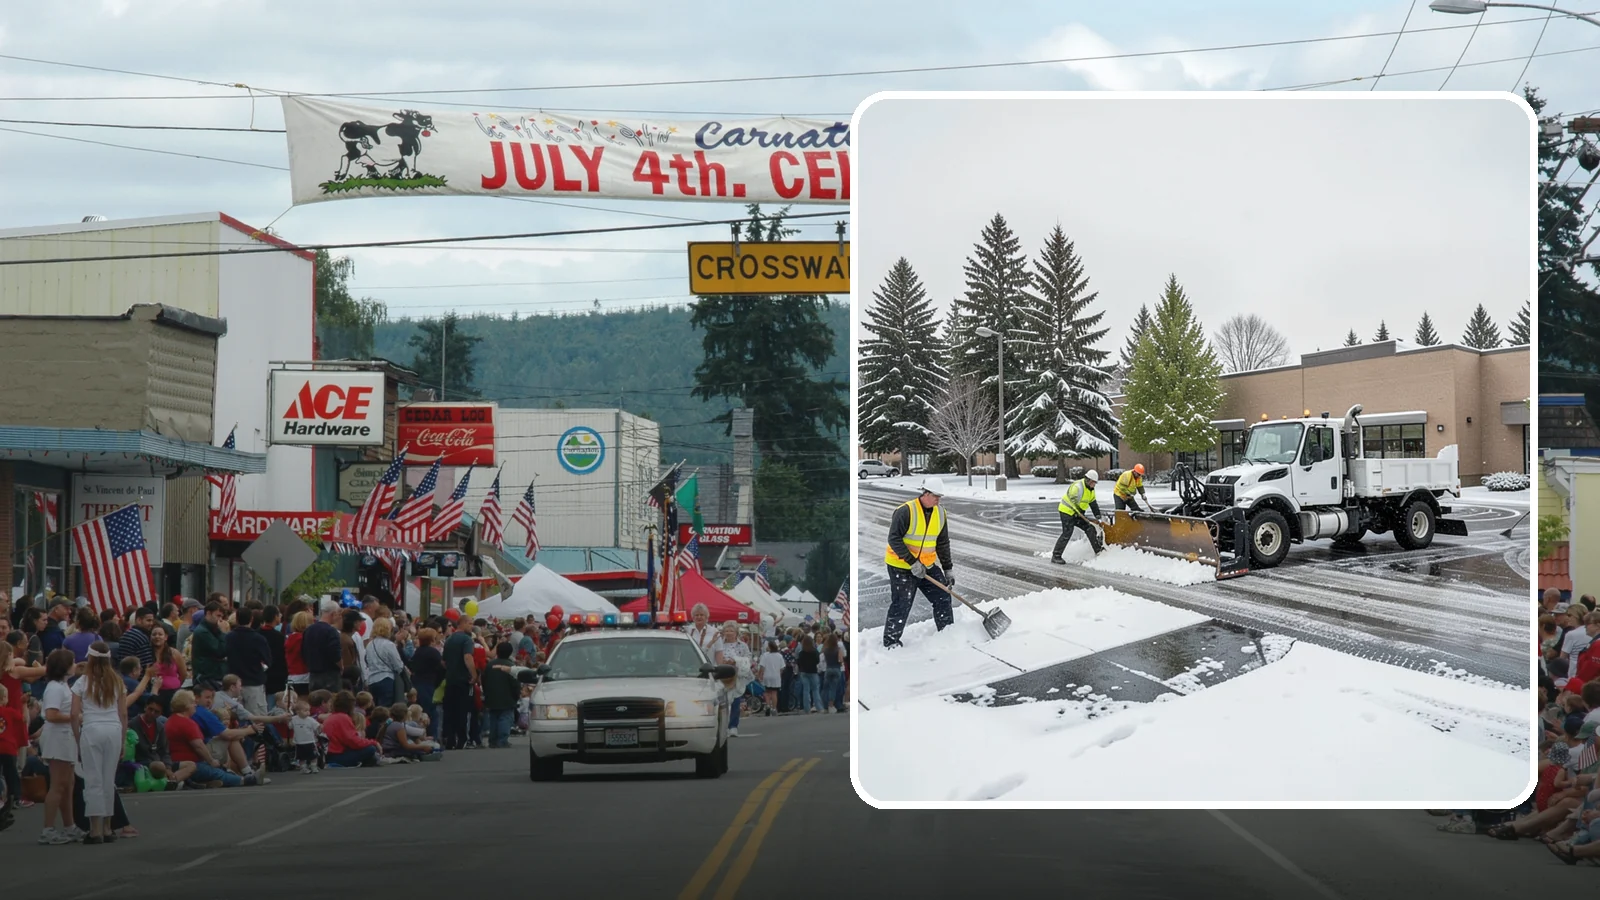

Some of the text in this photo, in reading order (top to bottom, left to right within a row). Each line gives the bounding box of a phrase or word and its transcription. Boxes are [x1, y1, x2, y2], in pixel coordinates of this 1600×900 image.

[481, 141, 604, 192] JULY
[632, 150, 746, 197] 4th.
[697, 254, 850, 280] CROSSWA
[283, 380, 373, 420] ACE
[406, 409, 485, 422] CEDAR LOG
[283, 421, 370, 436] Hardware
[353, 467, 389, 478] Simpl
[83, 485, 155, 495] St. Vincent de Paul
[212, 516, 330, 535] HARDARE
[688, 526, 741, 535] CRNATION
[699, 535, 730, 543] GLASS
